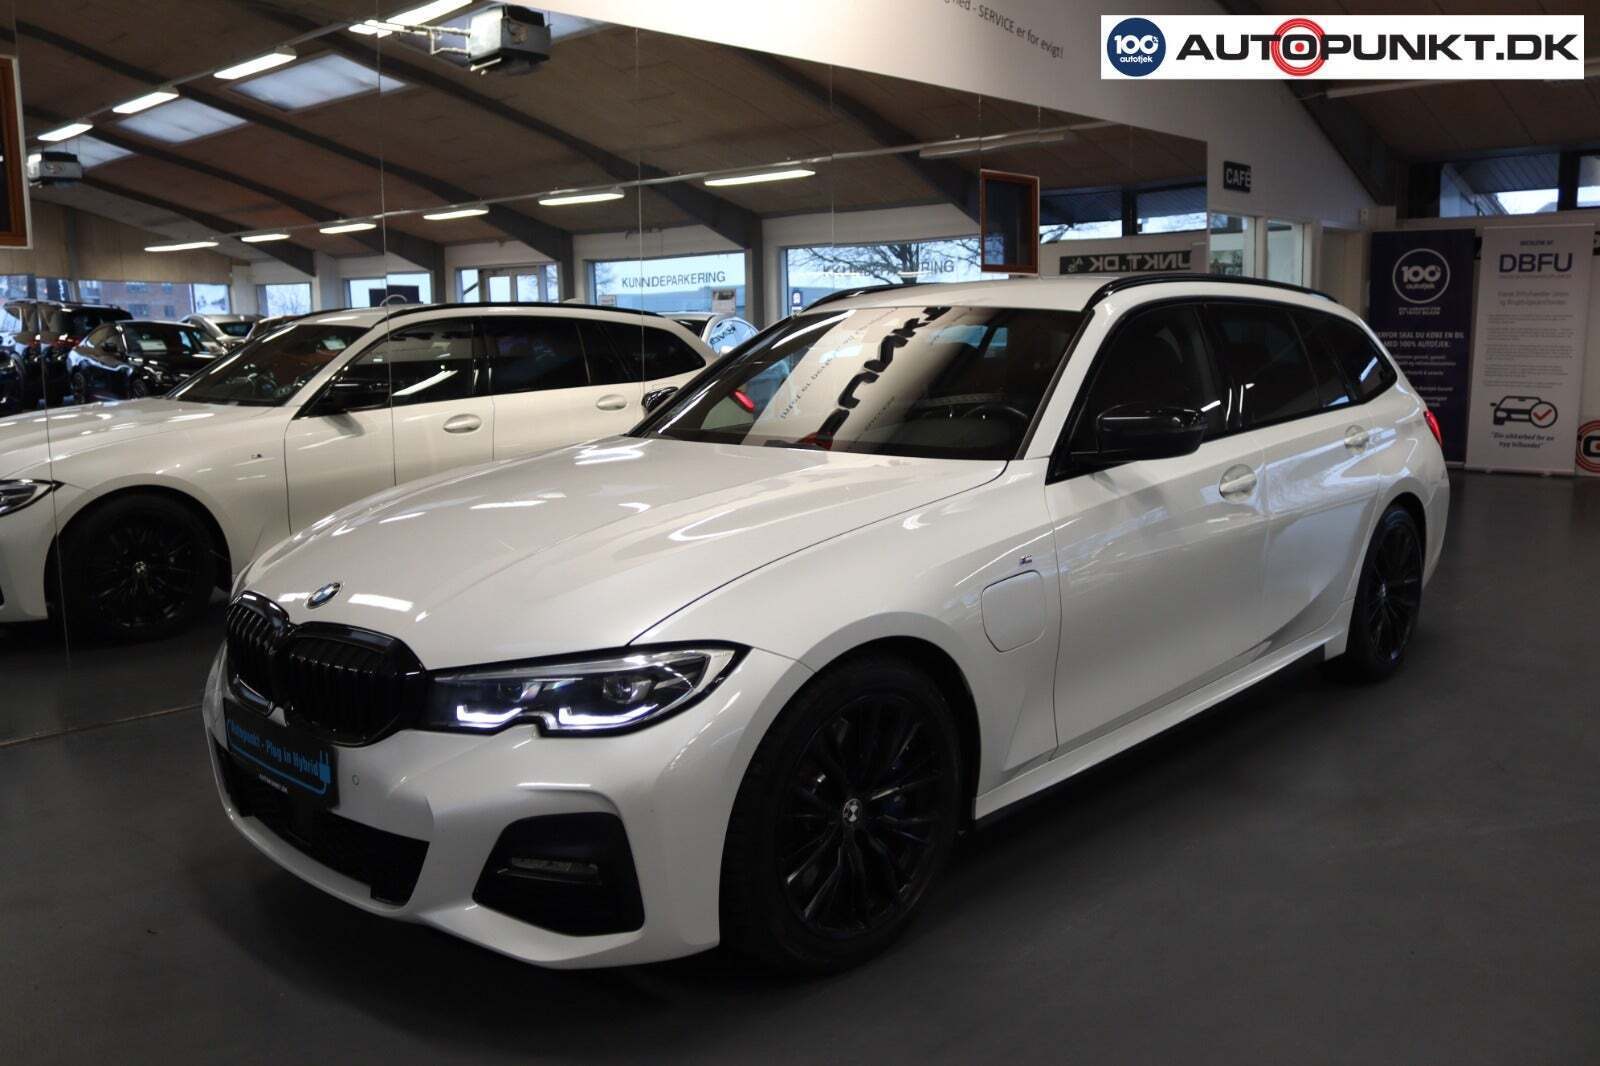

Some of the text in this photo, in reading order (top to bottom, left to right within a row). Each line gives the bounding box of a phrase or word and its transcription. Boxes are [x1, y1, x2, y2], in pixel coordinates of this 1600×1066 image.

[978, 4, 1015, 33] SERVICE
[1016, 27, 1025, 38] er
[1027, 29, 1040, 46] for
[1499, 253, 1573, 272] DBFU
